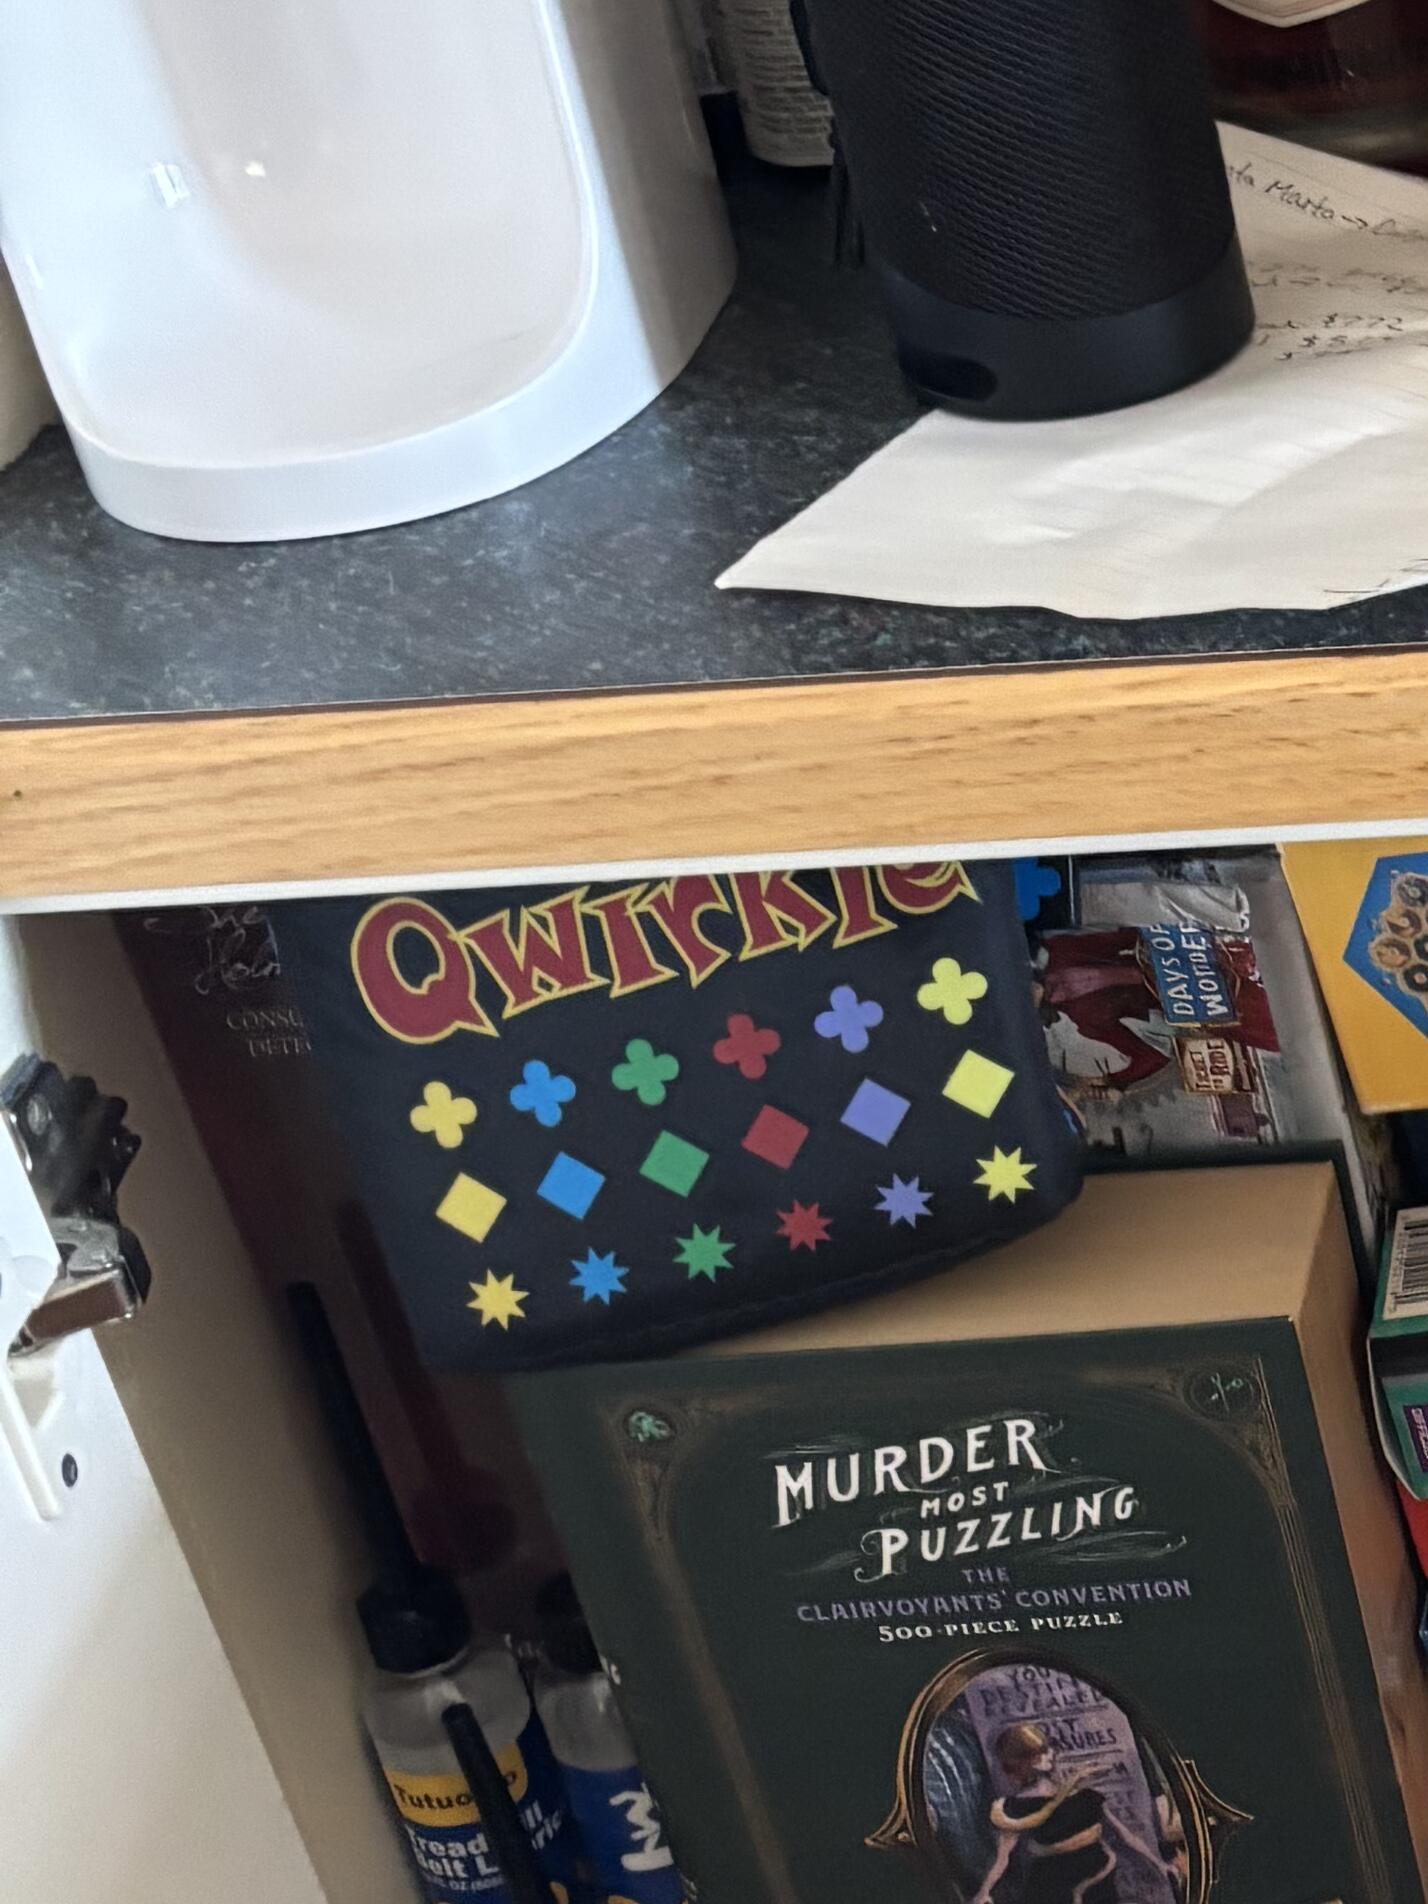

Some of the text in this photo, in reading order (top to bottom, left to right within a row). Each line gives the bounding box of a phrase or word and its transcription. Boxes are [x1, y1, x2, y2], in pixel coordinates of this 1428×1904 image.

[1161, 957, 1195, 1016] DAYS
[772, 1418, 1062, 1528] MURDER
[920, 1480, 1010, 1520] MOST
[854, 1486, 1140, 1583] PUZZLING
[962, 1567, 1010, 1585] THE
[798, 1578, 1193, 1622] CLAIRVOYANTS' CONVENTION
[1031, 1610, 1124, 1630] PUZZLE
